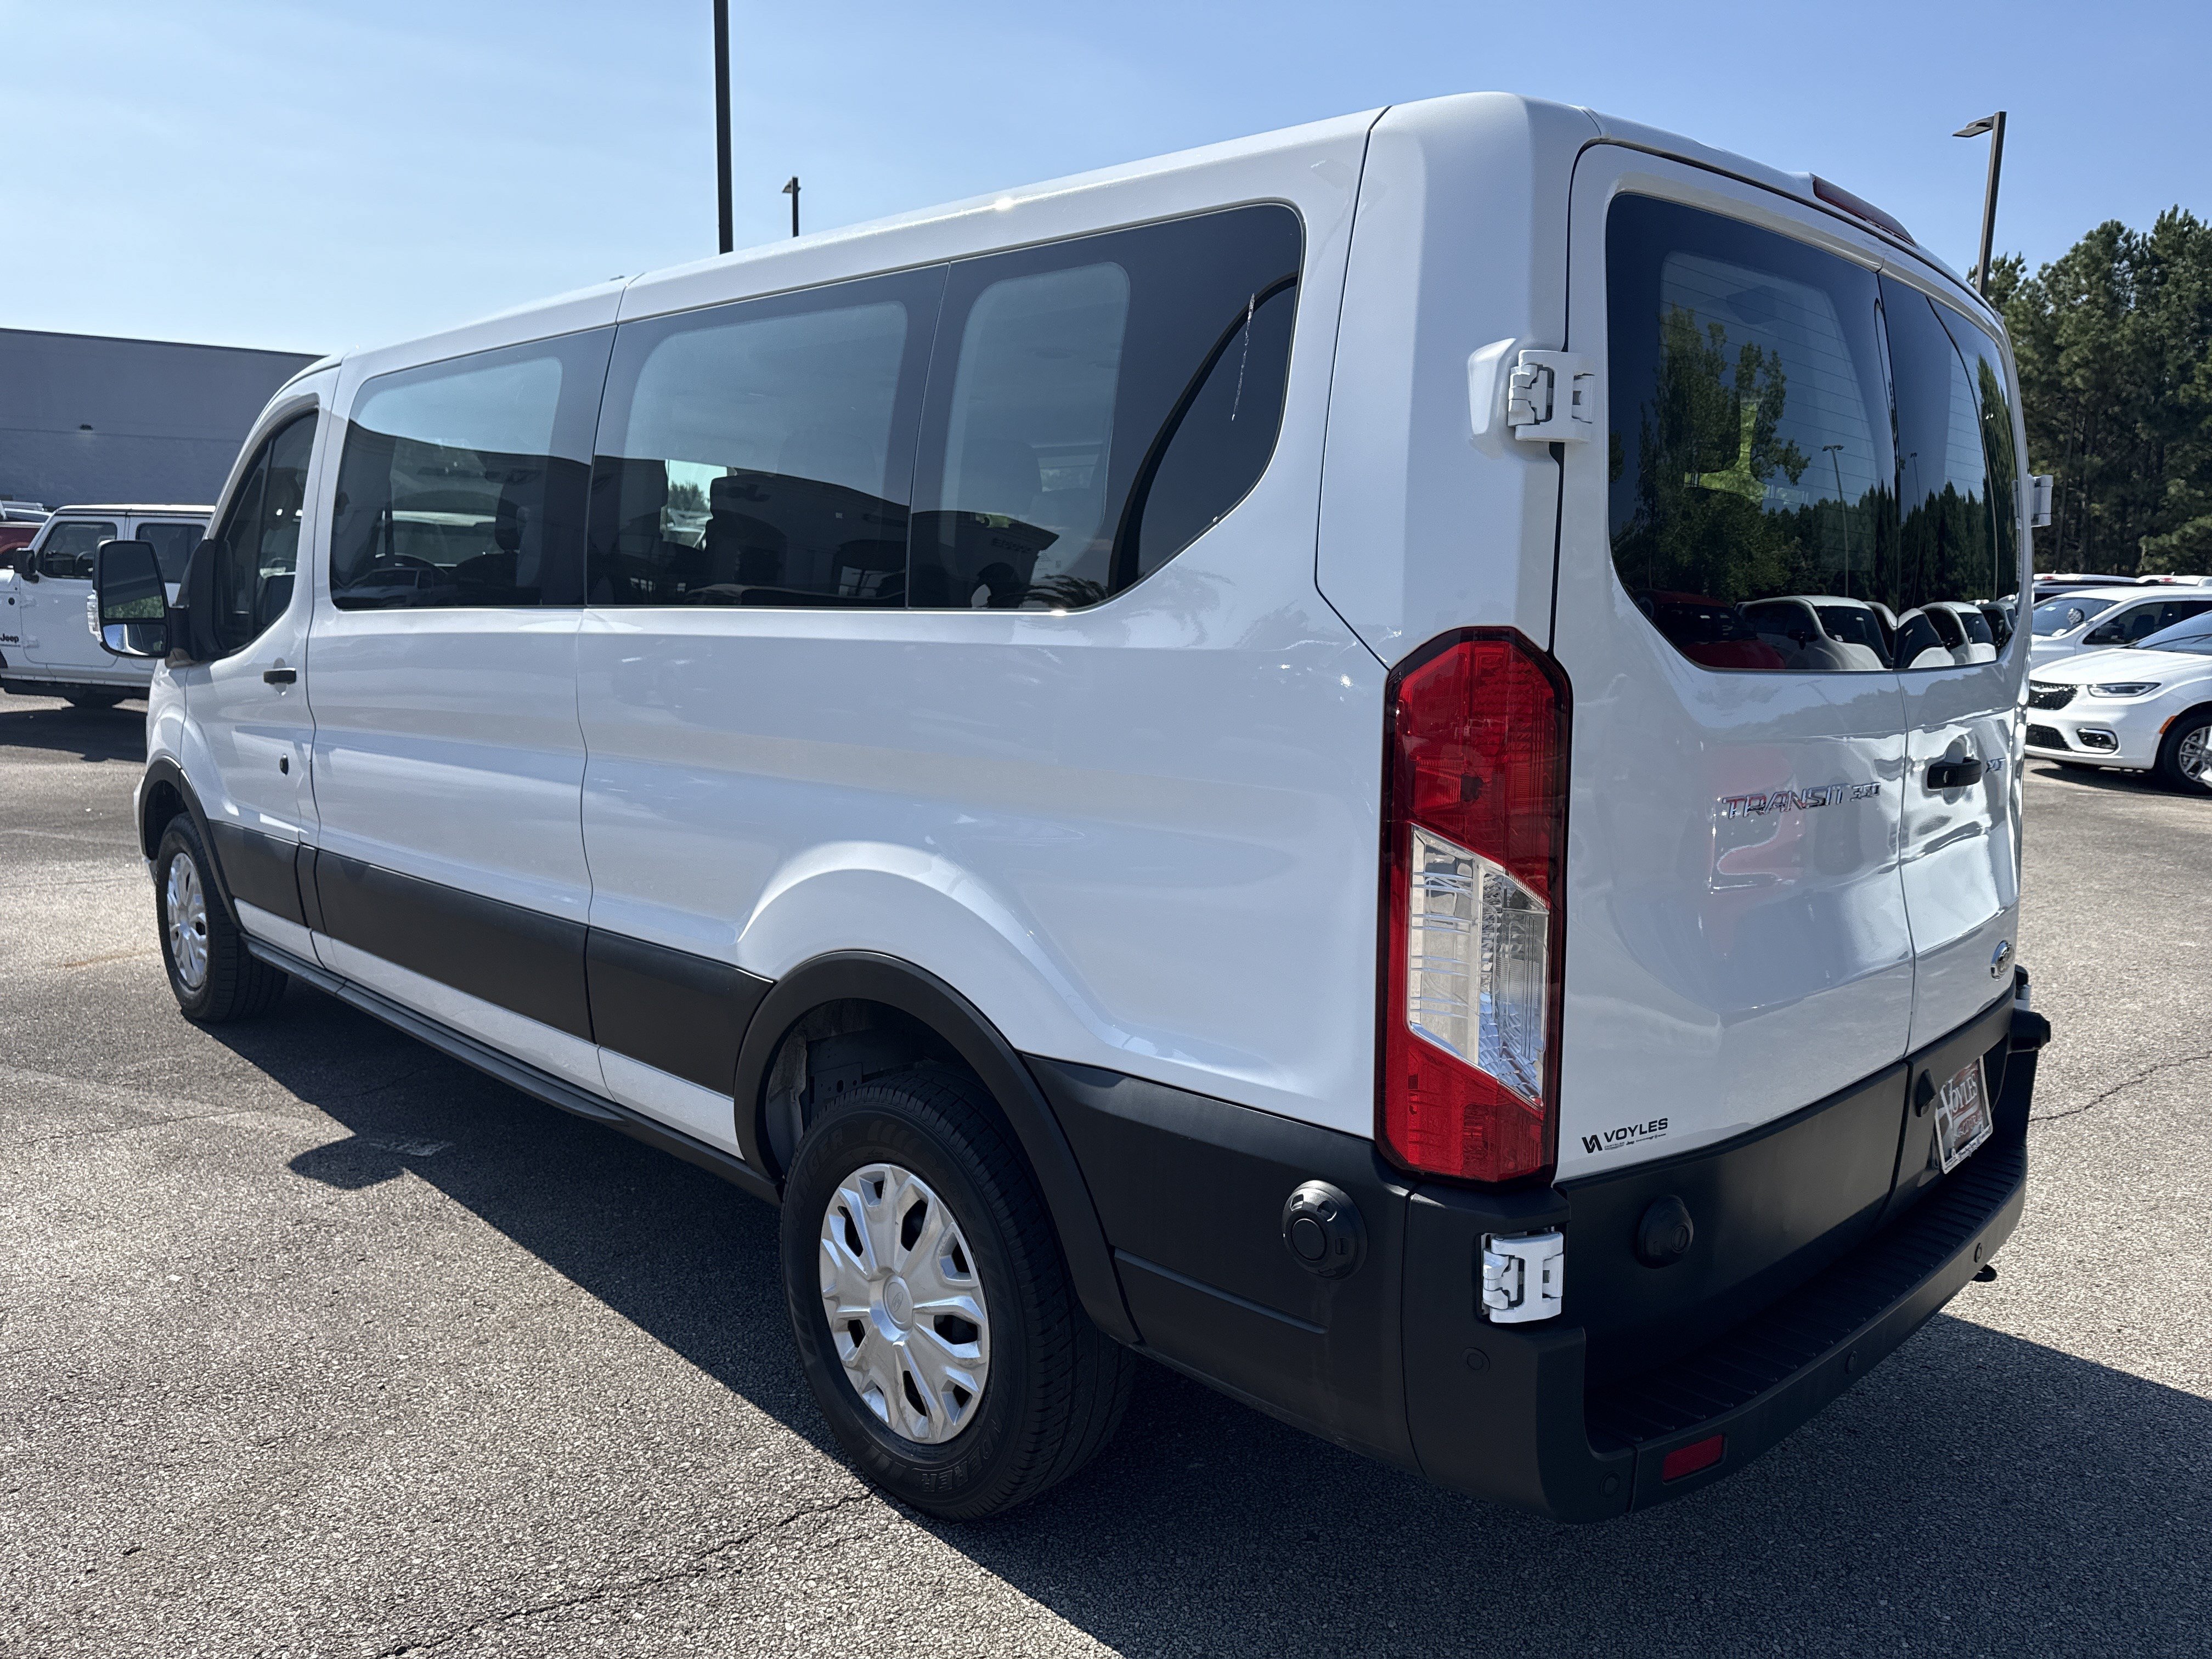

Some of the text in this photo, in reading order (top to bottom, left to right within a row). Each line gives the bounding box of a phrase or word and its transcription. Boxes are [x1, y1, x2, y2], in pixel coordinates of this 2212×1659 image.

[0, 633, 19, 644] Jeep
[1723, 782, 1881, 819] TRANSIT 350
[1940, 1073, 1978, 1128] VOYLES
[1604, 1118, 1668, 1142] VOYLES
